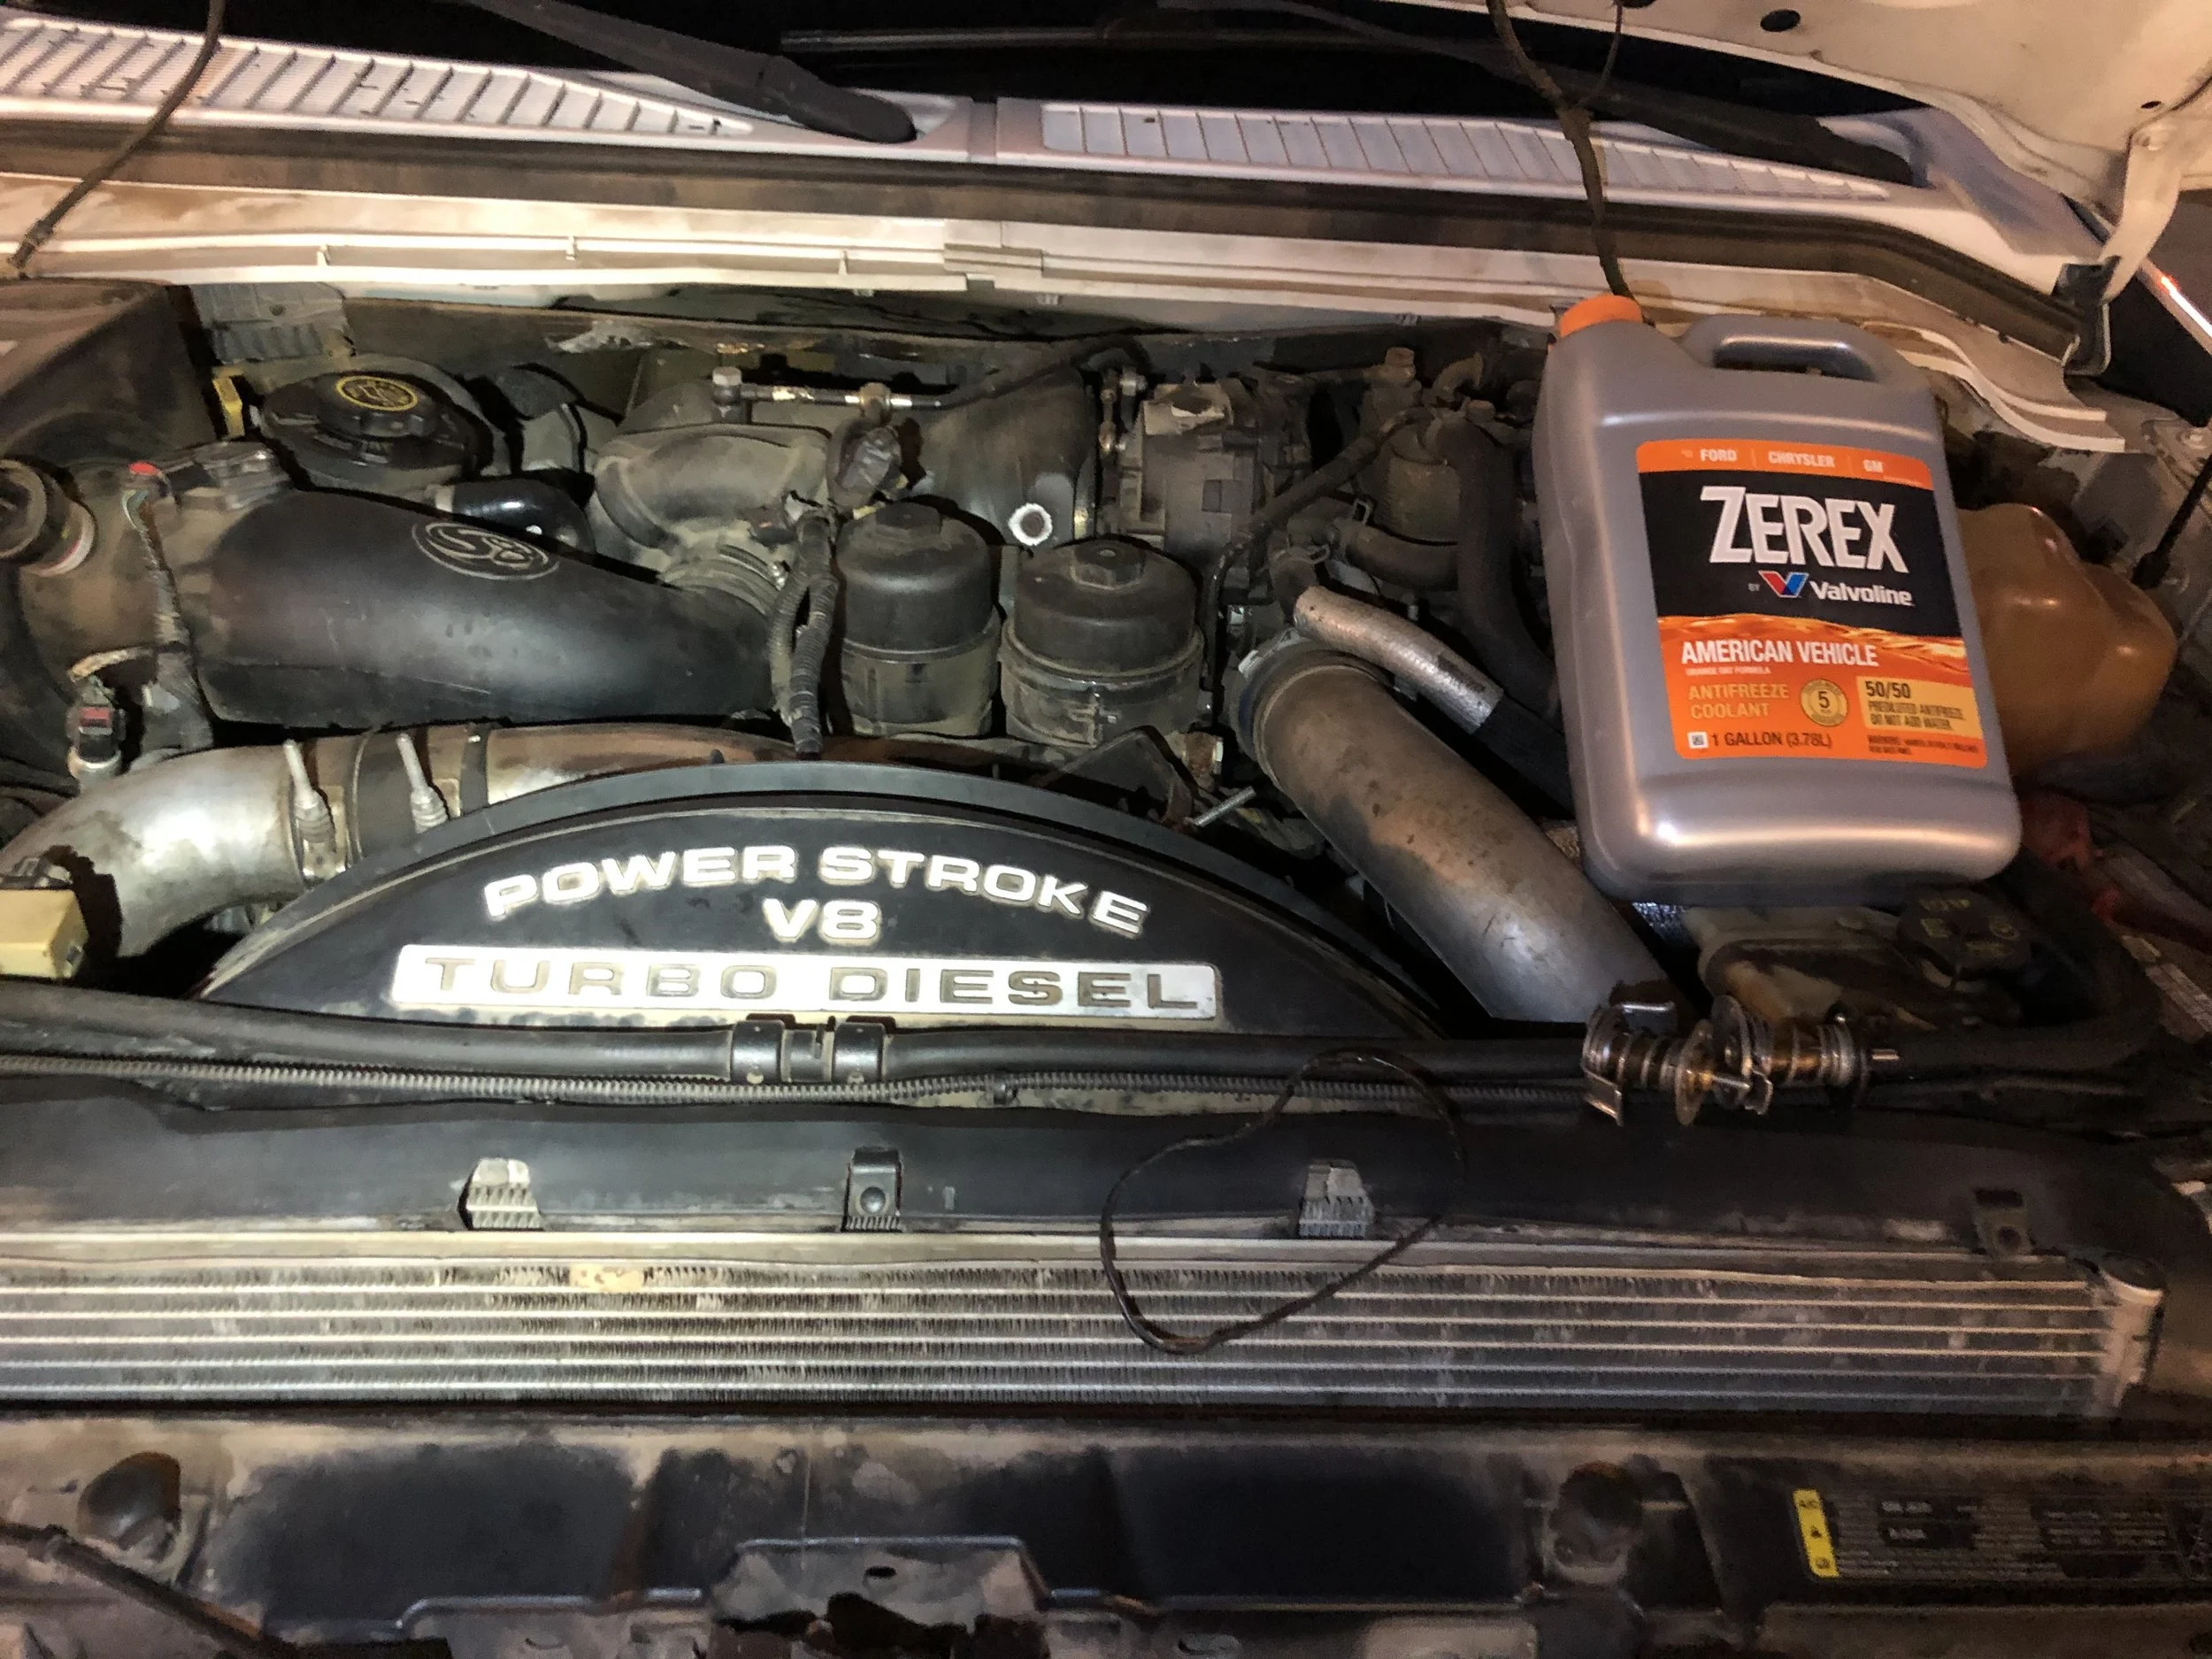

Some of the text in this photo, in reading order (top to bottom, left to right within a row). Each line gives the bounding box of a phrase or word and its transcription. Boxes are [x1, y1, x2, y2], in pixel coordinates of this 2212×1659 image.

[1700, 449, 1738, 462] FORD
[1768, 451, 1835, 469] CHRYSLER
[1700, 486, 1909, 573] ZEREX
[1809, 580, 1914, 607] Valvoline
[1682, 639, 1879, 666] AMERICAN VEHICLE
[1688, 683, 1789, 701] ANTIFREEZE
[1818, 691, 1830, 709] 5
[1864, 680, 1911, 699] 50/50
[1691, 703, 1769, 720] COOLANT
[1712, 733, 1719, 747] 1
[1724, 732, 1782, 747] GALLON
[484, 845, 1150, 938] POWER STROKE
[762, 896, 881, 946] V8
[425, 957, 1198, 1009] TURBO DIESEL
